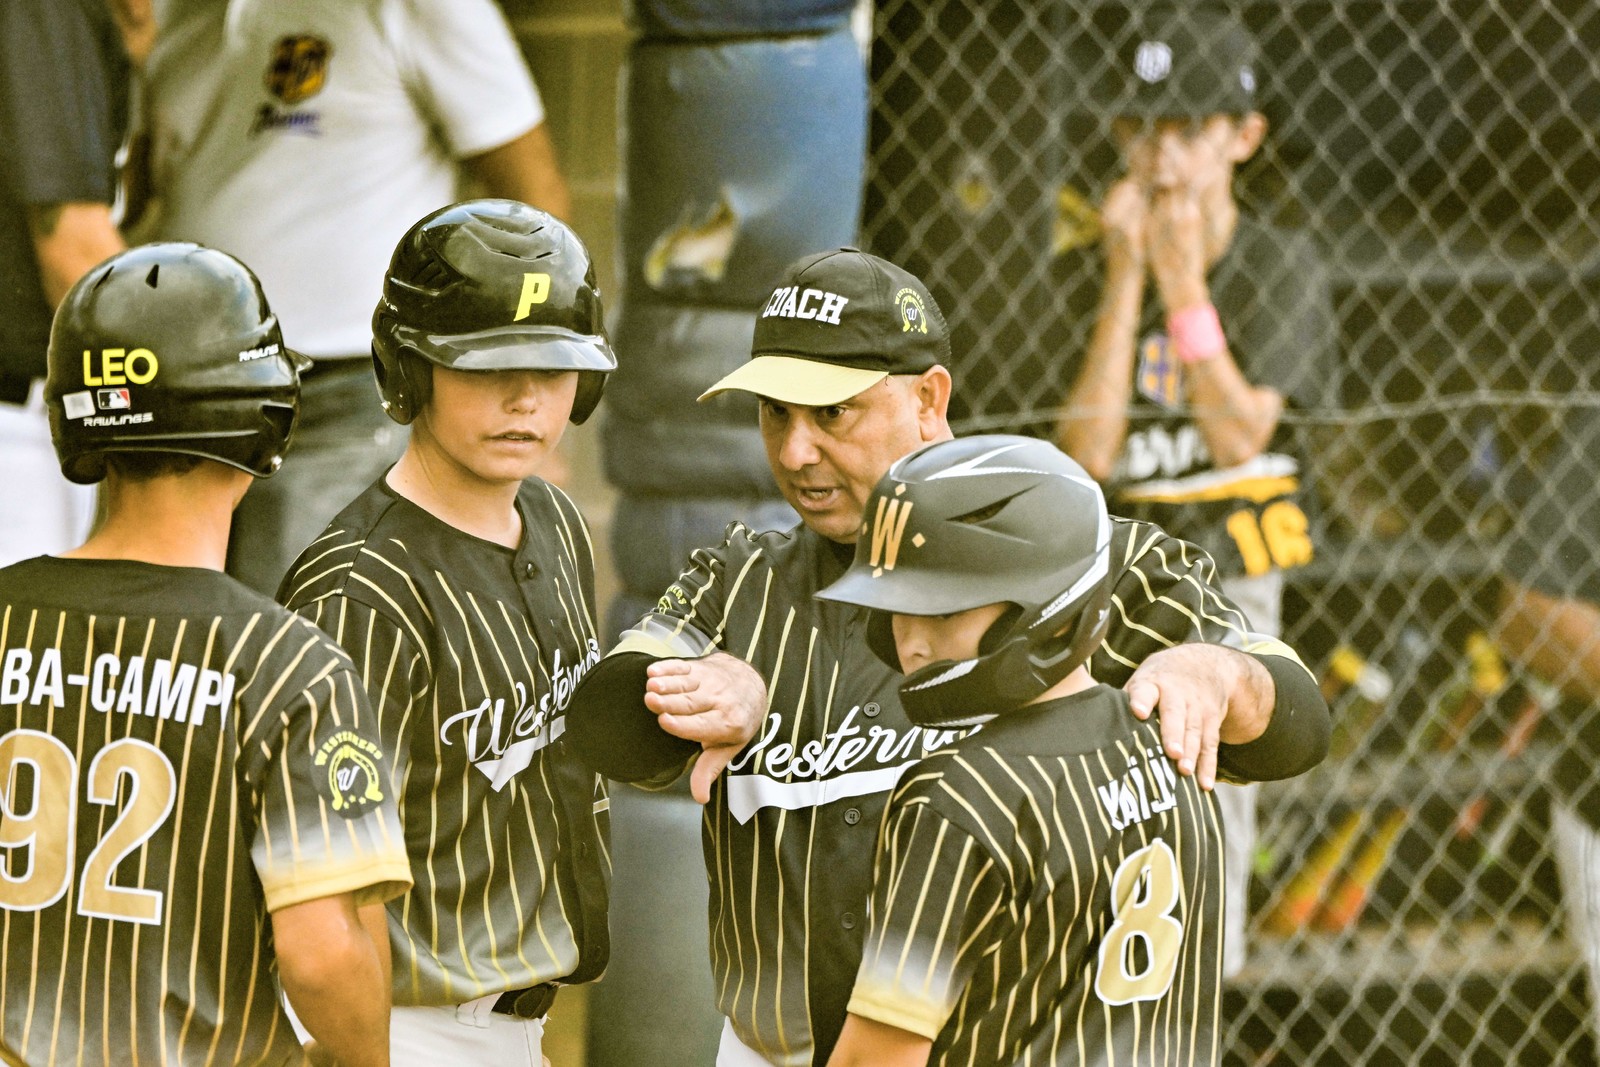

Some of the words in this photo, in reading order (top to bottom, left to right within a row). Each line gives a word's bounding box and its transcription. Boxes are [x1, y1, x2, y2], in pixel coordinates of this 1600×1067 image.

[513, 272, 551, 321] P
[762, 285, 849, 325] COACH
[83, 348, 159, 387] LEO
[83, 411, 154, 427] RAWLINGS
[869, 496, 914, 571] W
[0, 728, 177, 926] 92
[1094, 836, 1184, 1007] 8
